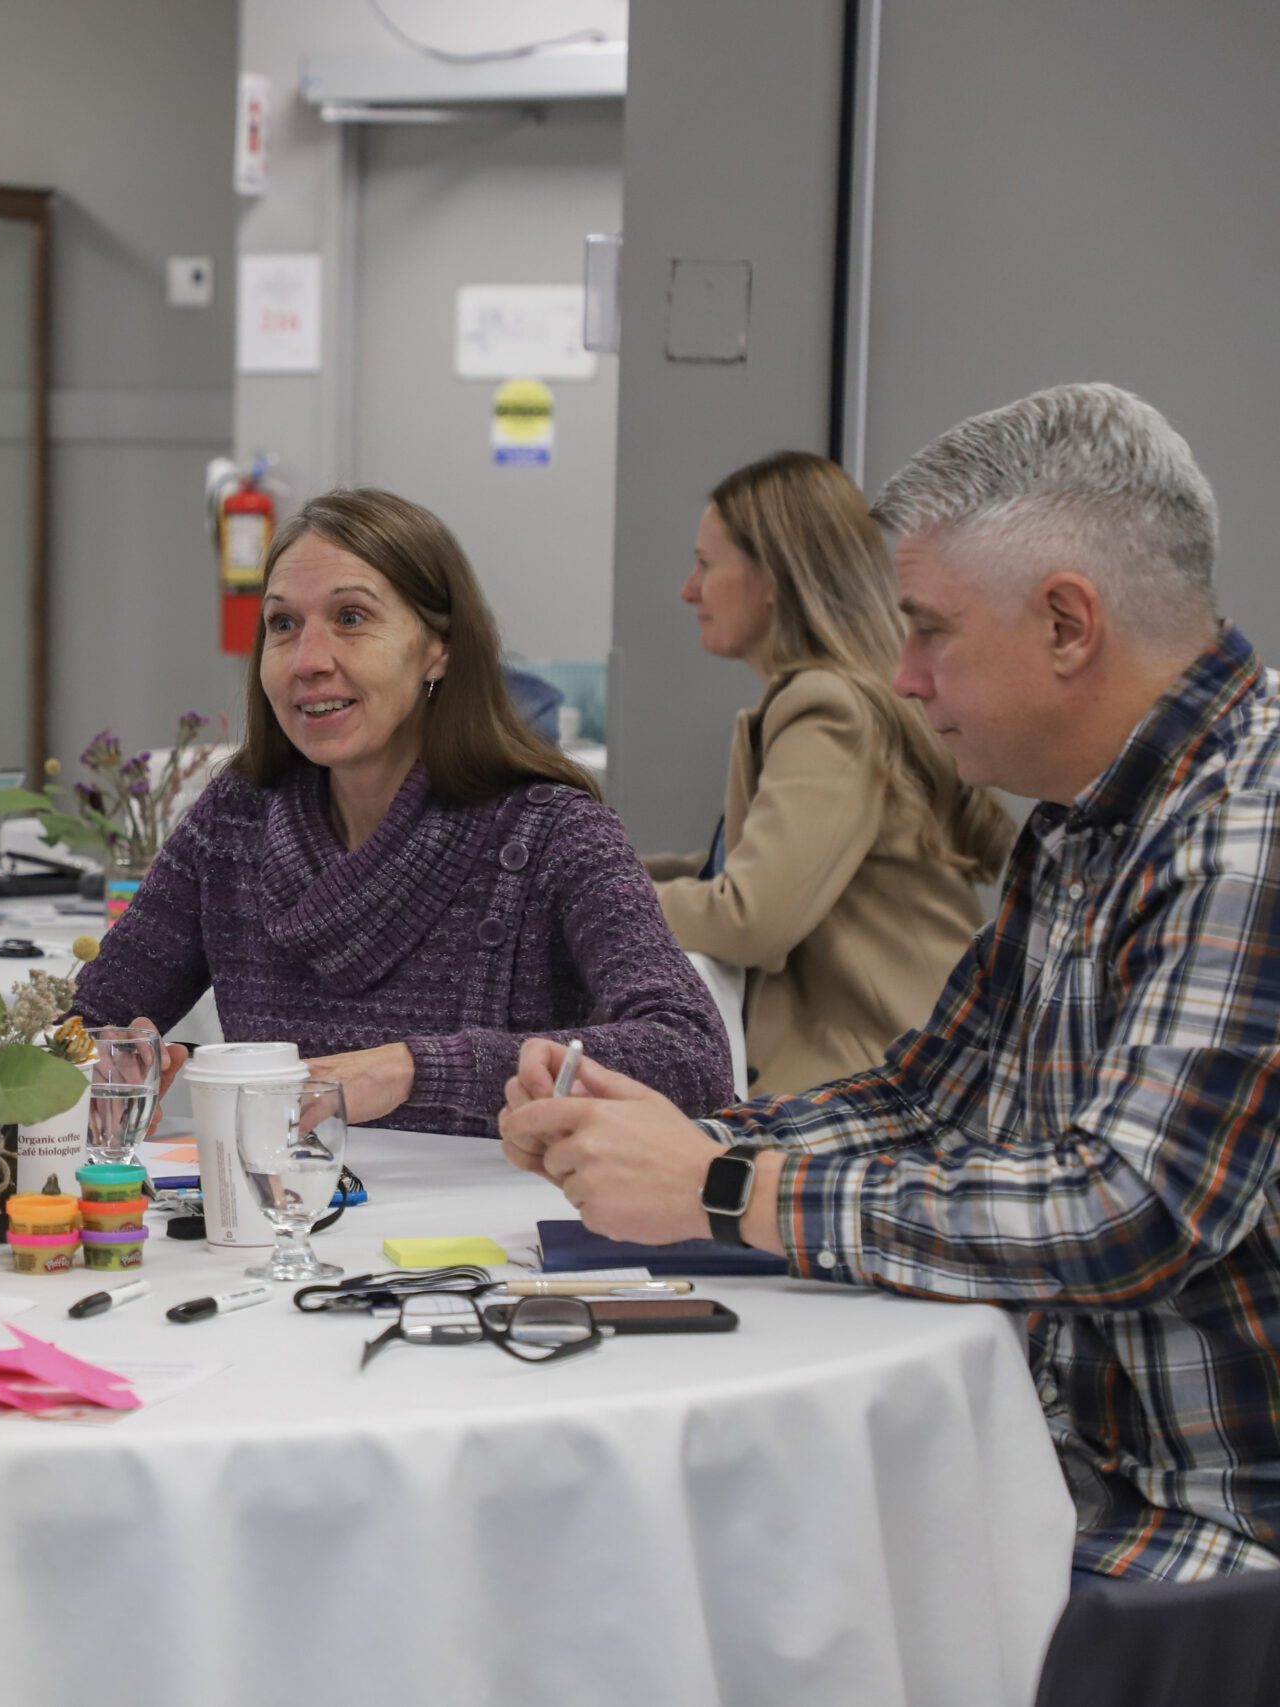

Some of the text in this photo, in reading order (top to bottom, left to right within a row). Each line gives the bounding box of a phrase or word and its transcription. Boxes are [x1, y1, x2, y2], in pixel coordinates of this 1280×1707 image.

[18, 1132, 81, 1146] Organic coffee
[38, 1145, 81, 1157] biologique
